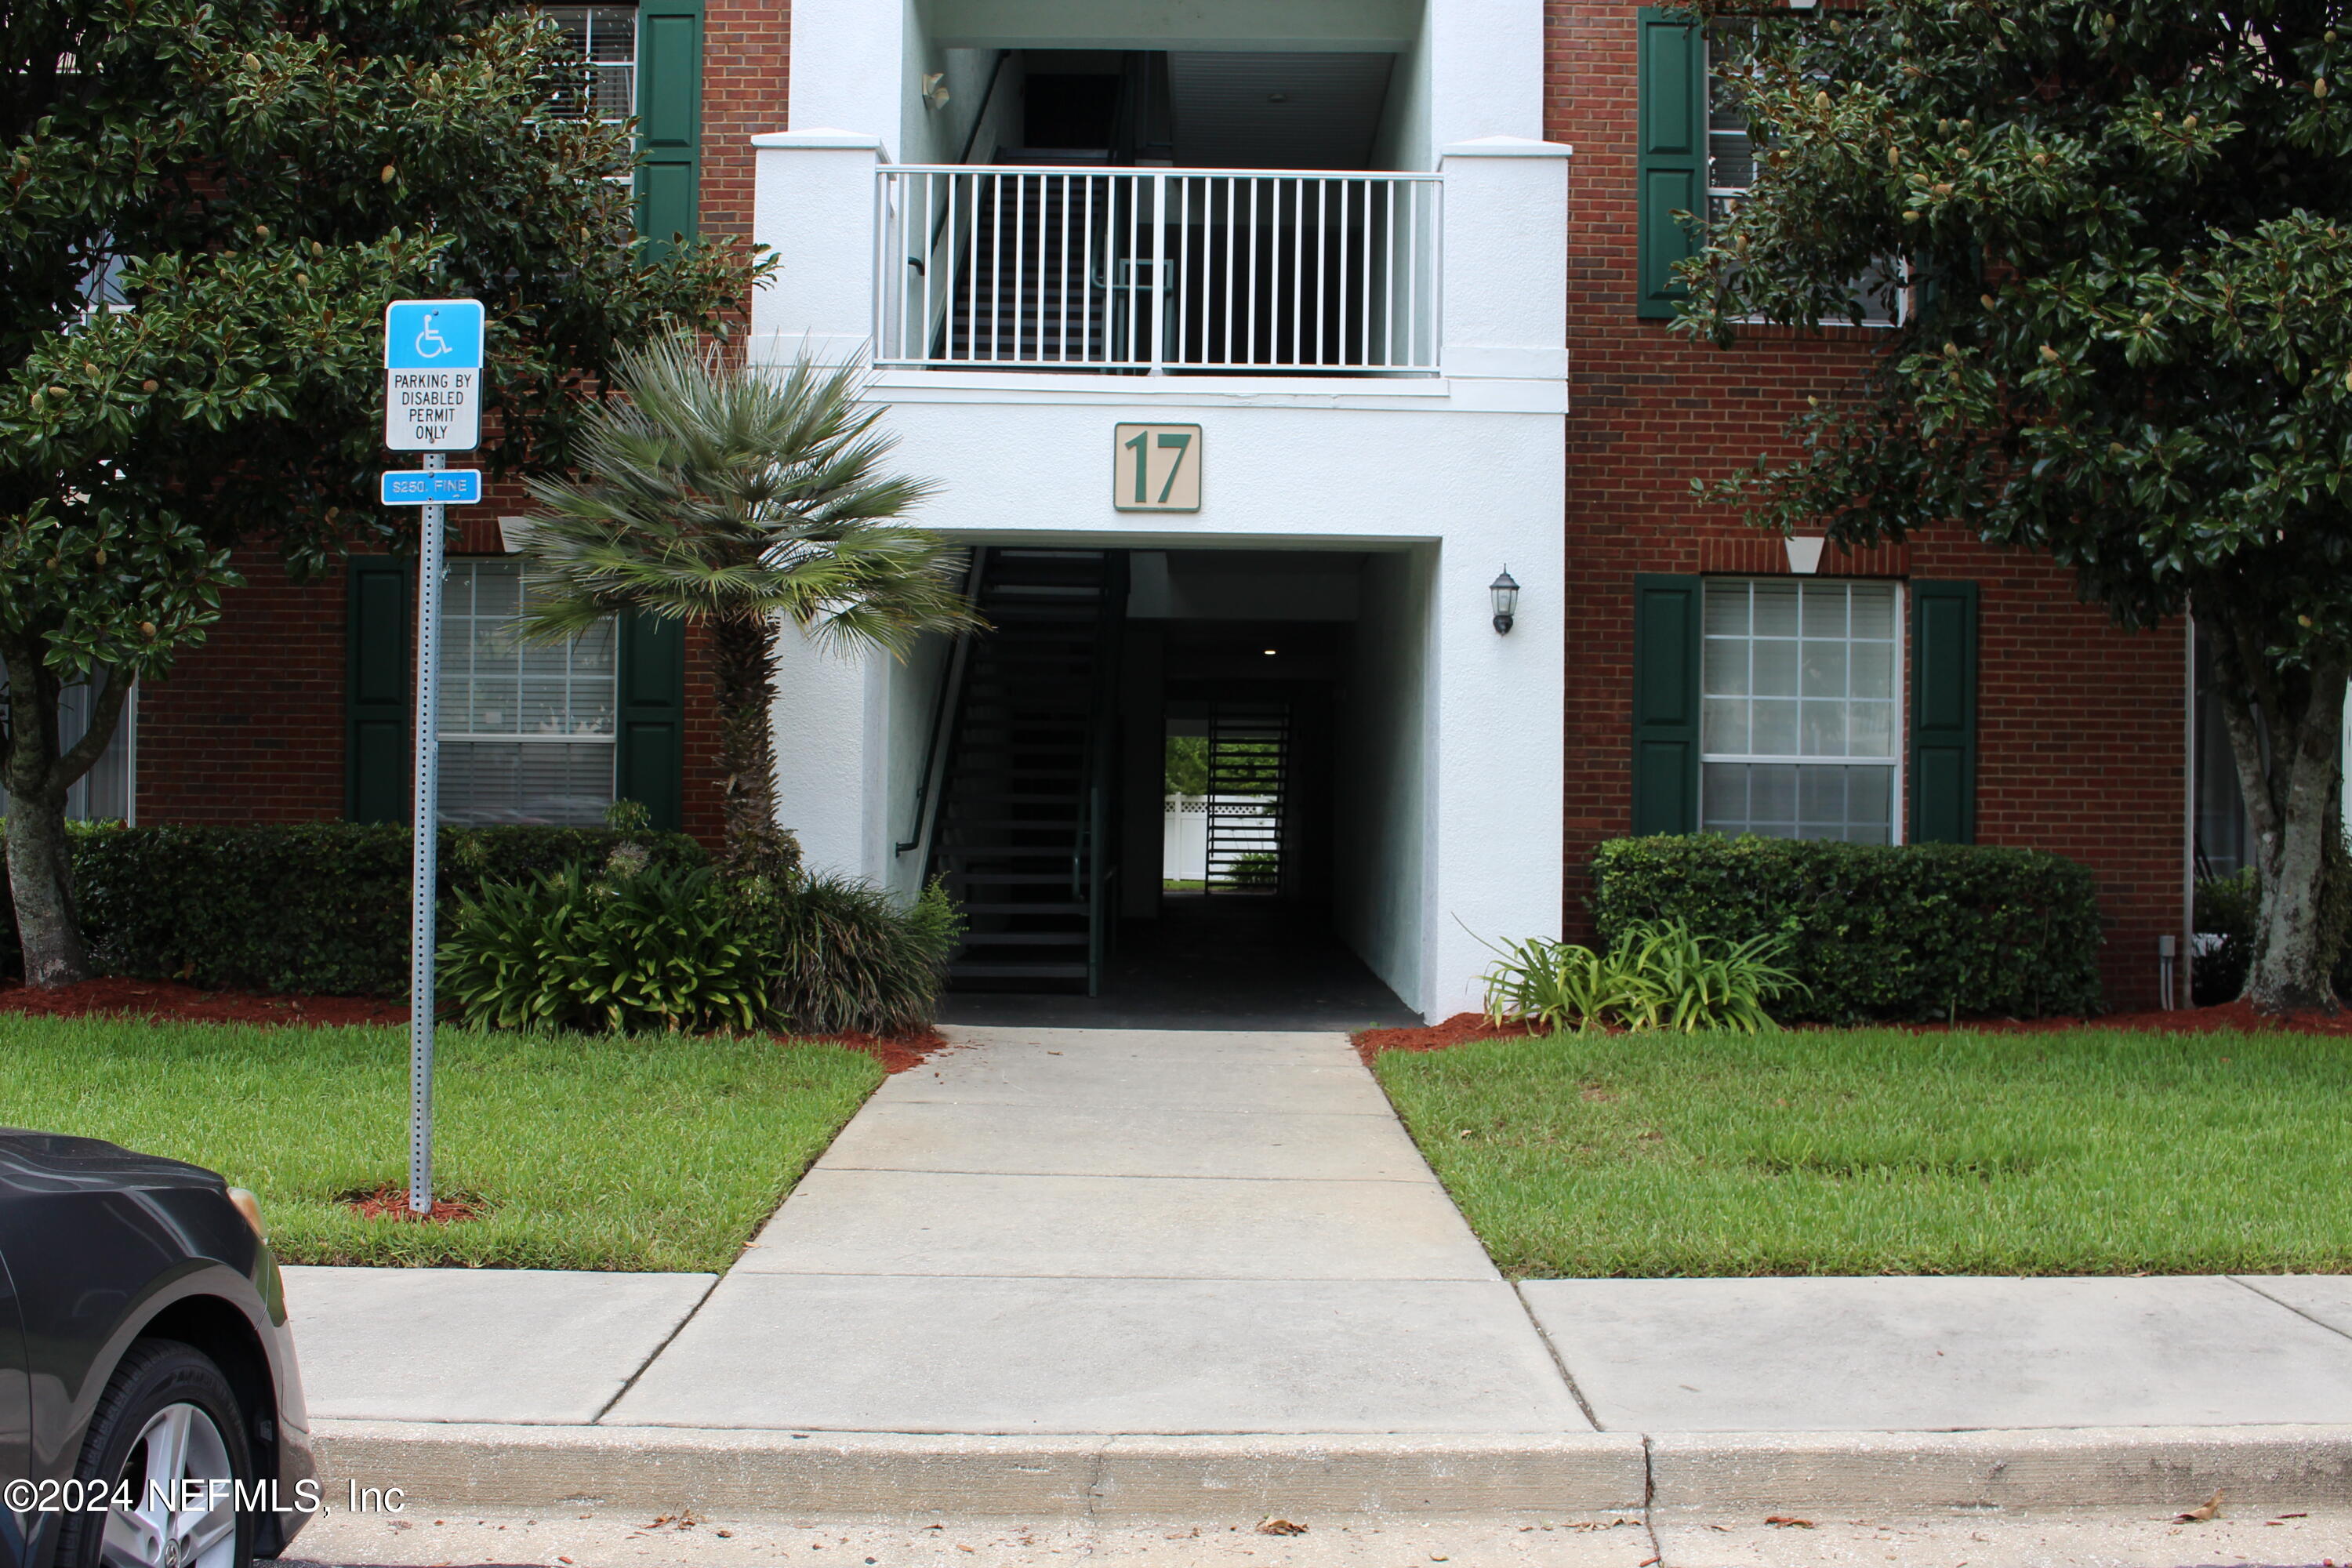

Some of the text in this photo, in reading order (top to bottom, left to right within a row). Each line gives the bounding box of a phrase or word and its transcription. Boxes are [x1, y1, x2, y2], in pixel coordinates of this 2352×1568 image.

[394, 374, 472, 389] PARKING BY
[402, 391, 464, 405] DISABLED
[409, 408, 456, 423] PERMIT
[416, 426, 448, 440] ONLY
[1124, 430, 1192, 503] 17
[434, 479, 467, 492] FINE
